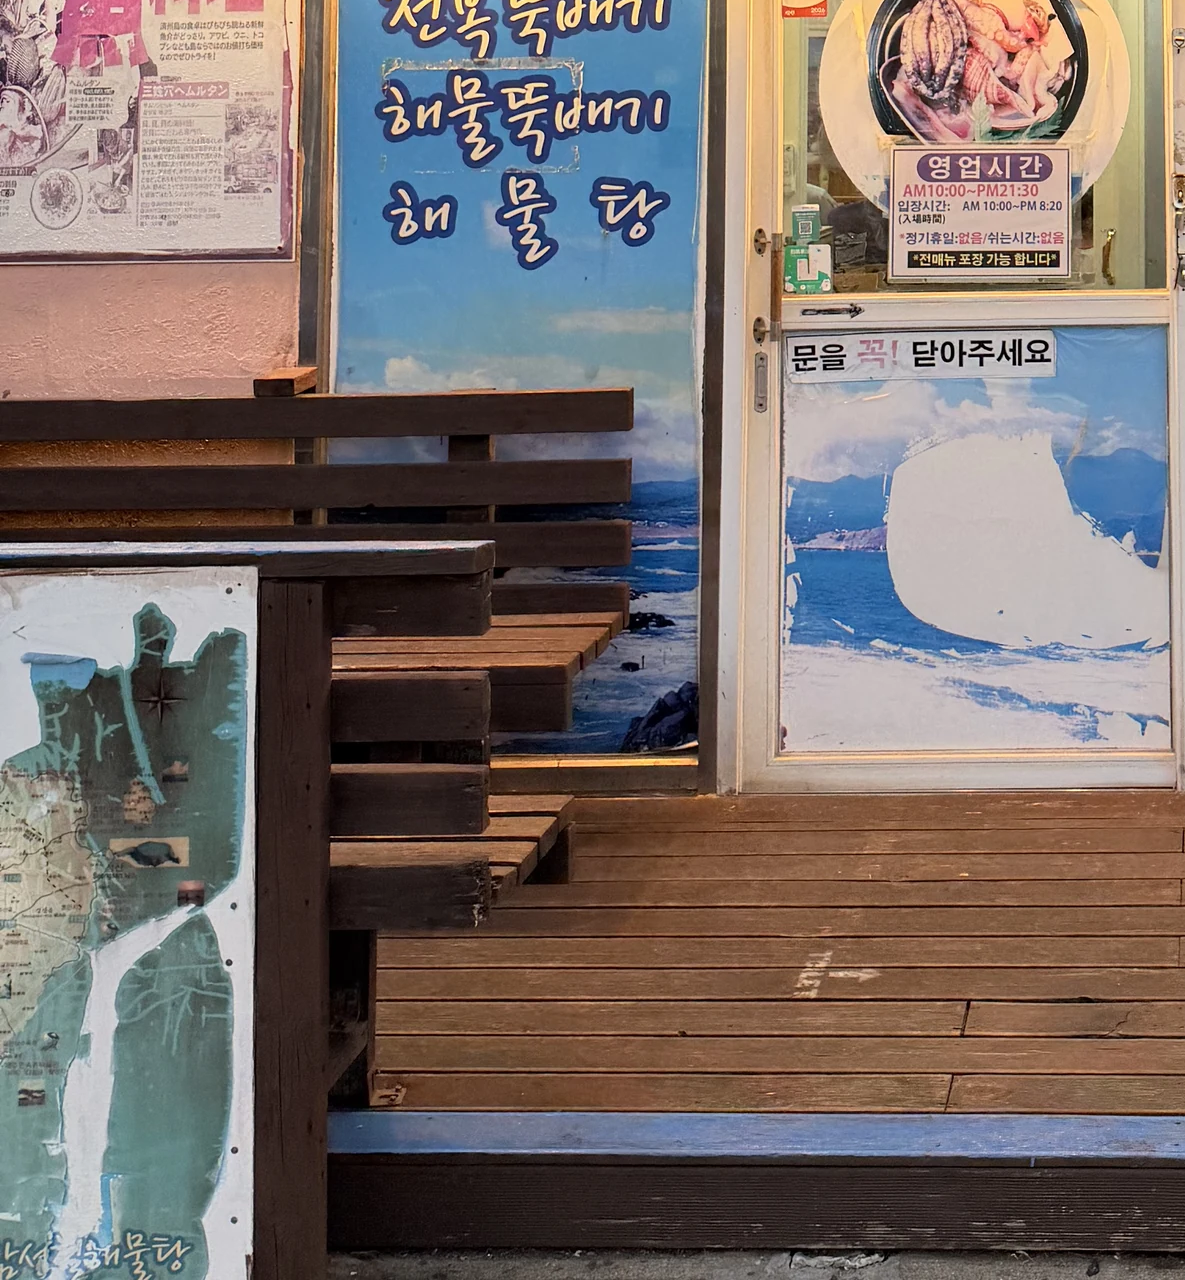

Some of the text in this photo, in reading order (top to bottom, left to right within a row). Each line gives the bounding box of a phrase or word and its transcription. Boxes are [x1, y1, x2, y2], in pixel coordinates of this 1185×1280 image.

[381, 73, 667, 163] 해물뚝배기
[928, 155, 1043, 179] 영업시간
[903, 184, 1039, 197] AM10:00~PM21:30
[897, 200, 951, 212] 입장시간:
[962, 201, 980, 211] AM
[1039, 201, 1063, 211] 8:20
[388, 175, 670, 264] 해물탕
[958, 253, 984, 266] 포장
[986, 253, 1011, 266] 가능
[791, 338, 1052, 372] 문을 꼭! 닫아주세요
